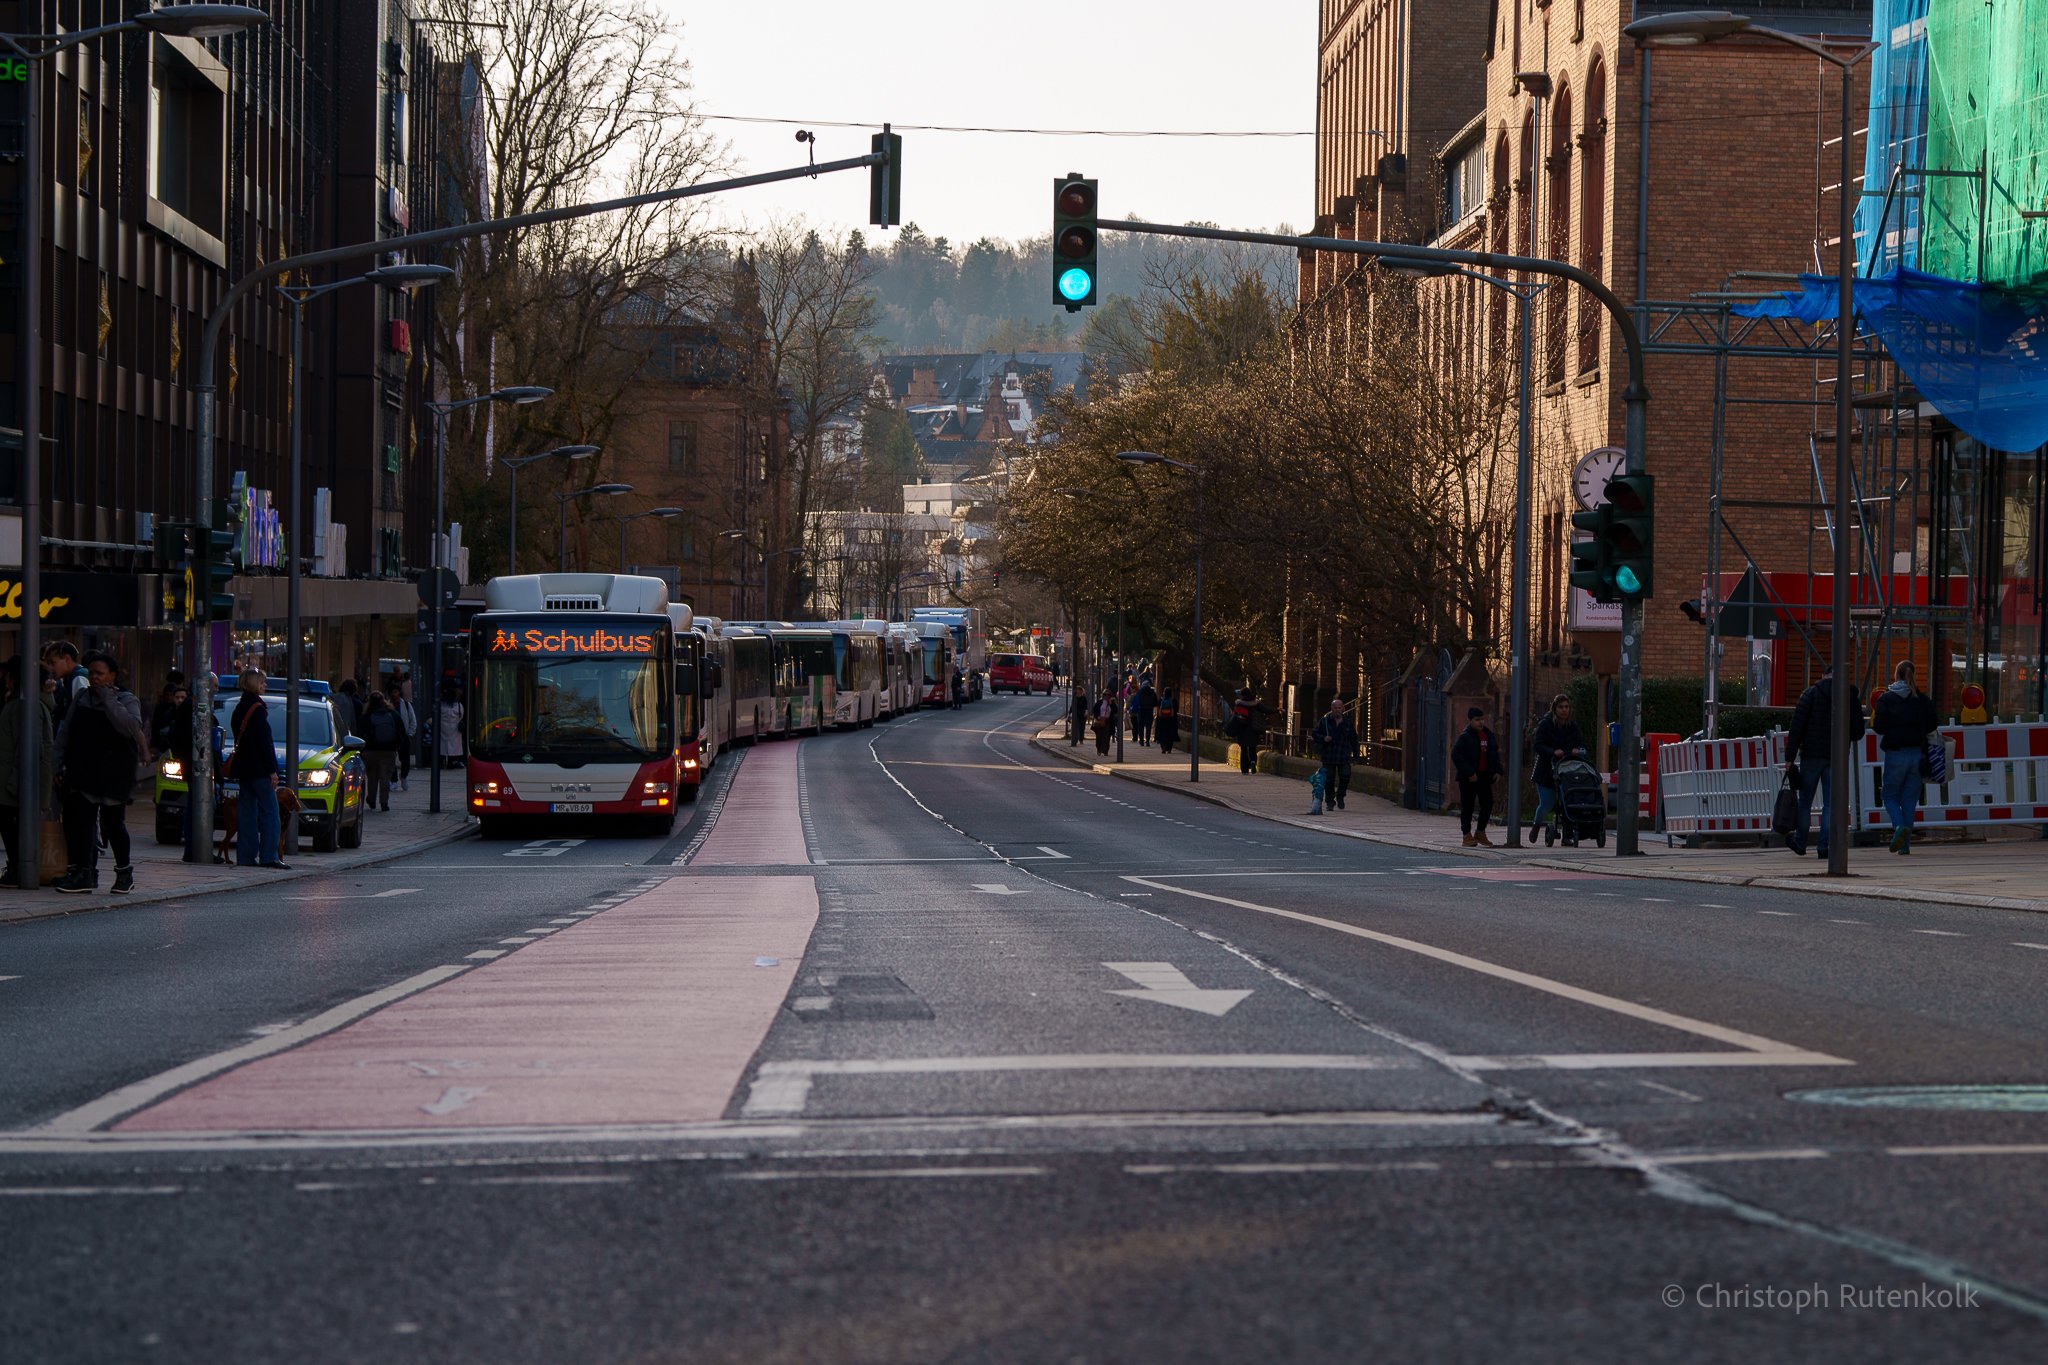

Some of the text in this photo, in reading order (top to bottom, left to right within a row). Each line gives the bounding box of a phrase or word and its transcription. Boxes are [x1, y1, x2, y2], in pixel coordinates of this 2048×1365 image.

[1586, 601, 1623, 611] Sparkass
[524, 629, 652, 652] Schulbus
[503, 786, 513, 795] 69
[555, 804, 590, 812] MR VB 69
